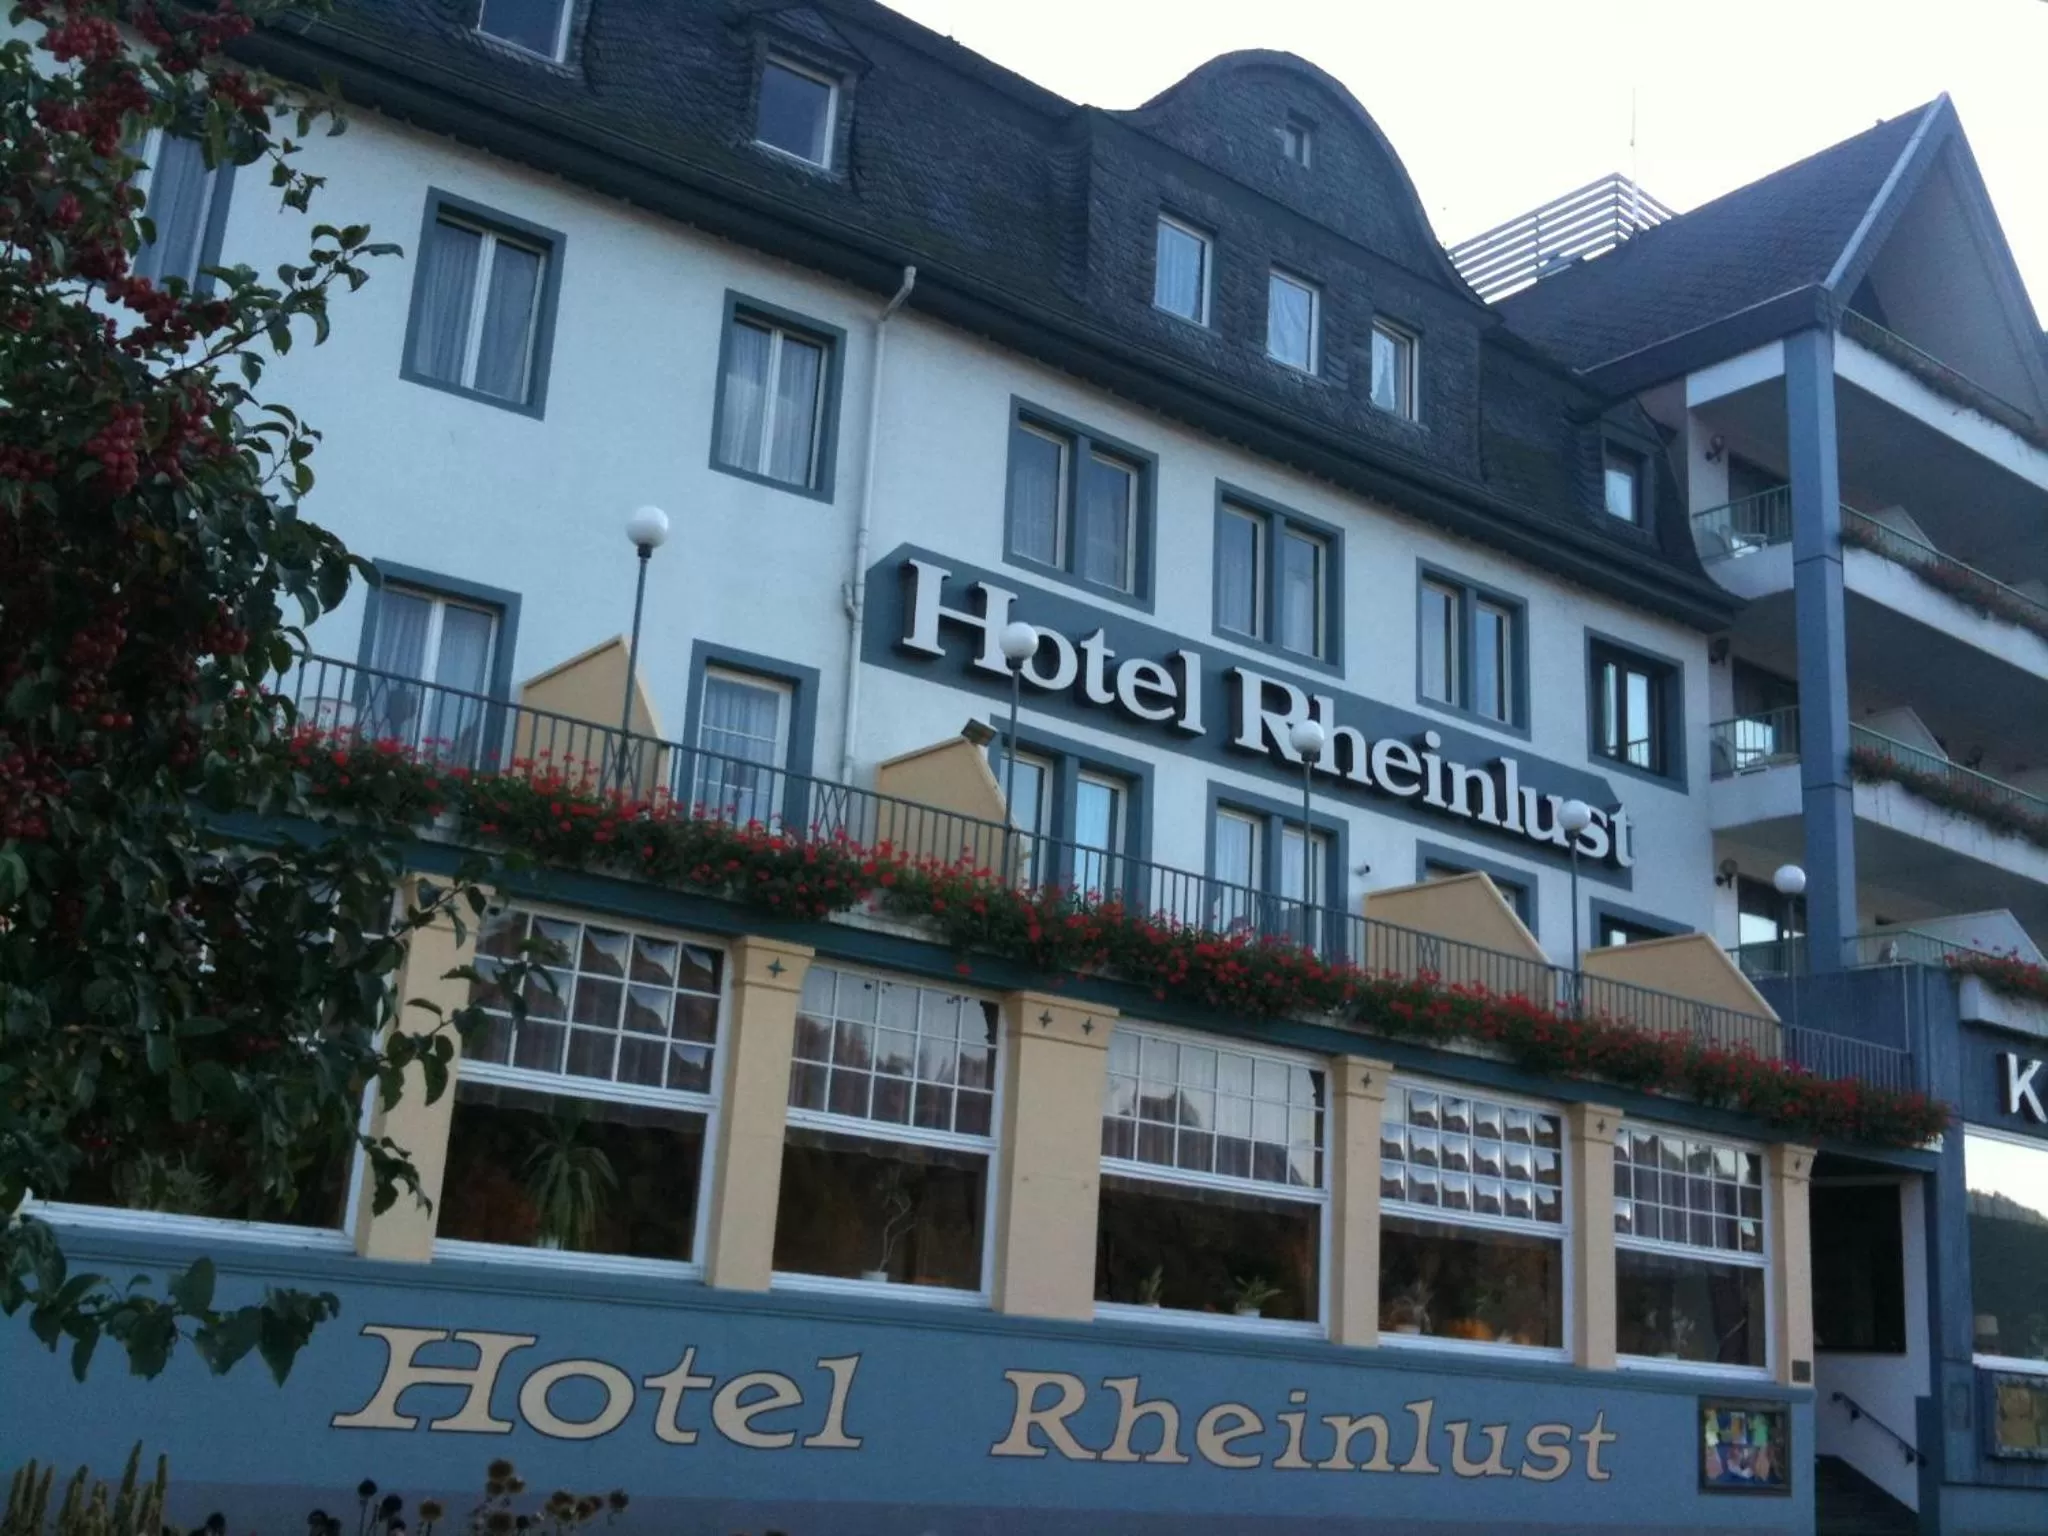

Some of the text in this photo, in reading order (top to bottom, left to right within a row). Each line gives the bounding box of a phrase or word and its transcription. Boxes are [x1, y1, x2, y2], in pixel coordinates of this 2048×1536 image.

[902, 558, 1635, 868] Hotel Rheinlust
[331, 1322, 1619, 1481] Hotel Rheinlust
